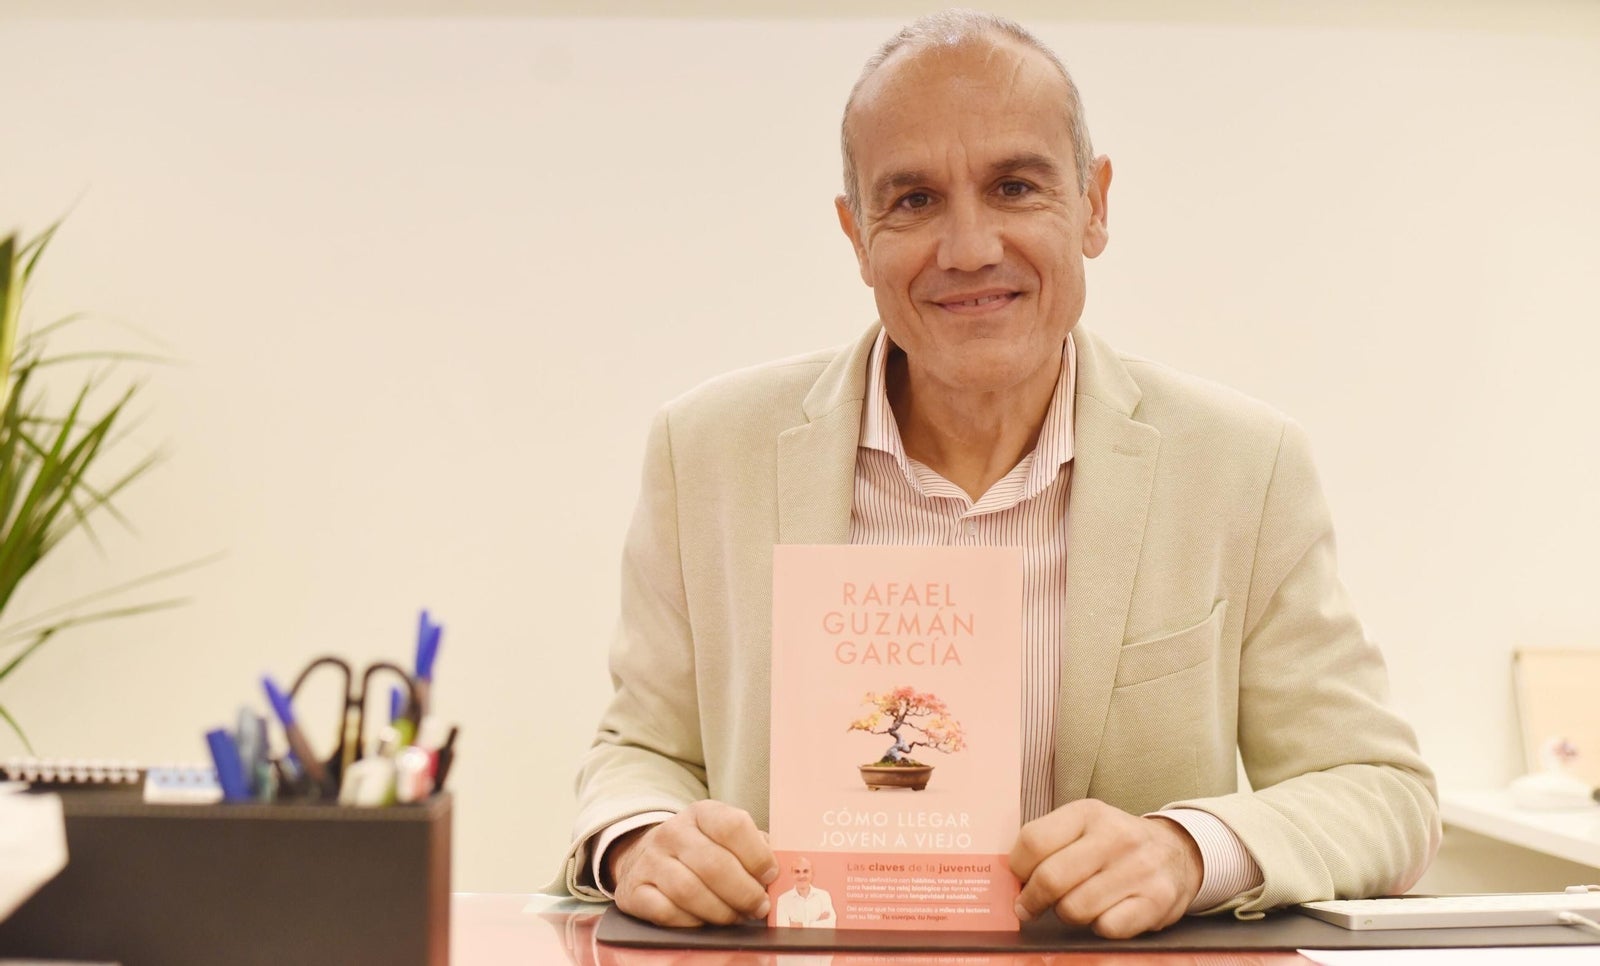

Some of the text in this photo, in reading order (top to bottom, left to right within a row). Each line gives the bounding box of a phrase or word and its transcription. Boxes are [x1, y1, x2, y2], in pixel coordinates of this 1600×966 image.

[843, 582, 956, 607] RAFAEL
[823, 607, 974, 636] GUZMÁN
[835, 637, 962, 666] GARCÍA
[822, 807, 970, 828] CÓMO LLEGAR
[820, 831, 971, 849] JOVEN A VIEJO
[847, 862, 992, 874] Las claves de la juventud
